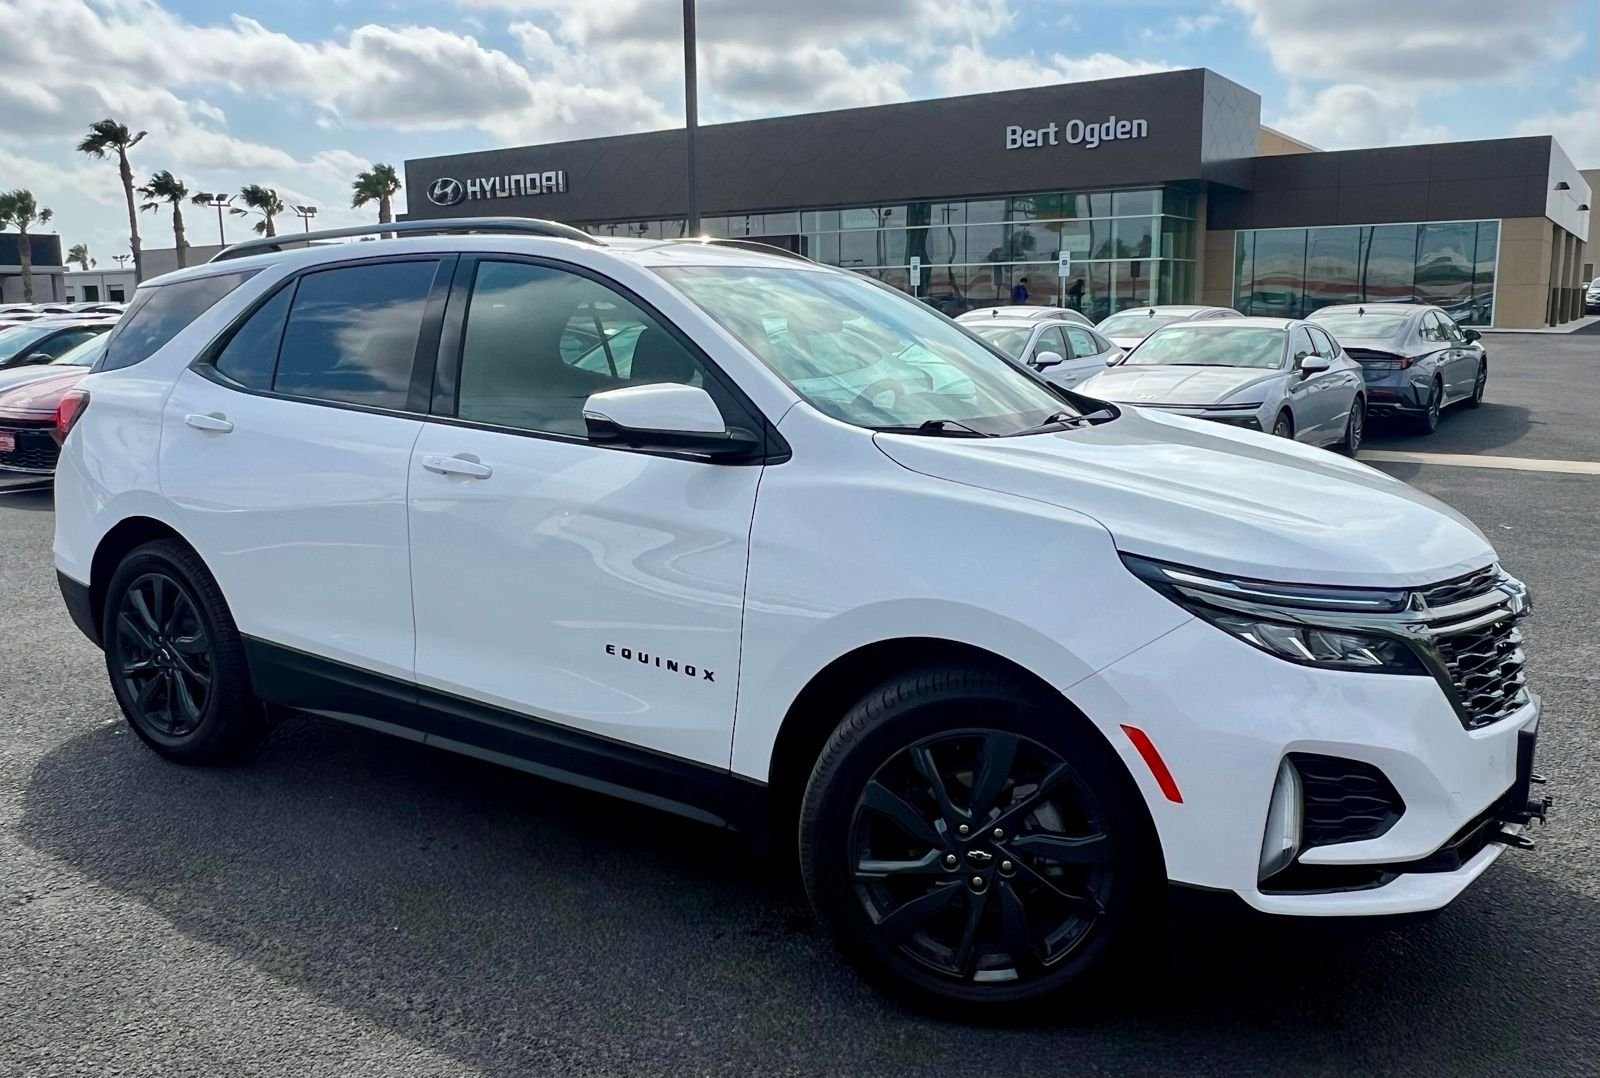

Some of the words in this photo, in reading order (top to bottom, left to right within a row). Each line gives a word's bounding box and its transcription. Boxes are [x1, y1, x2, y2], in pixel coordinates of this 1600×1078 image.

[1006, 122, 1059, 149] Bert
[1065, 115, 1148, 149] Ogden
[466, 170, 566, 200] HYUNDAI
[605, 643, 715, 682] EQUINOX
